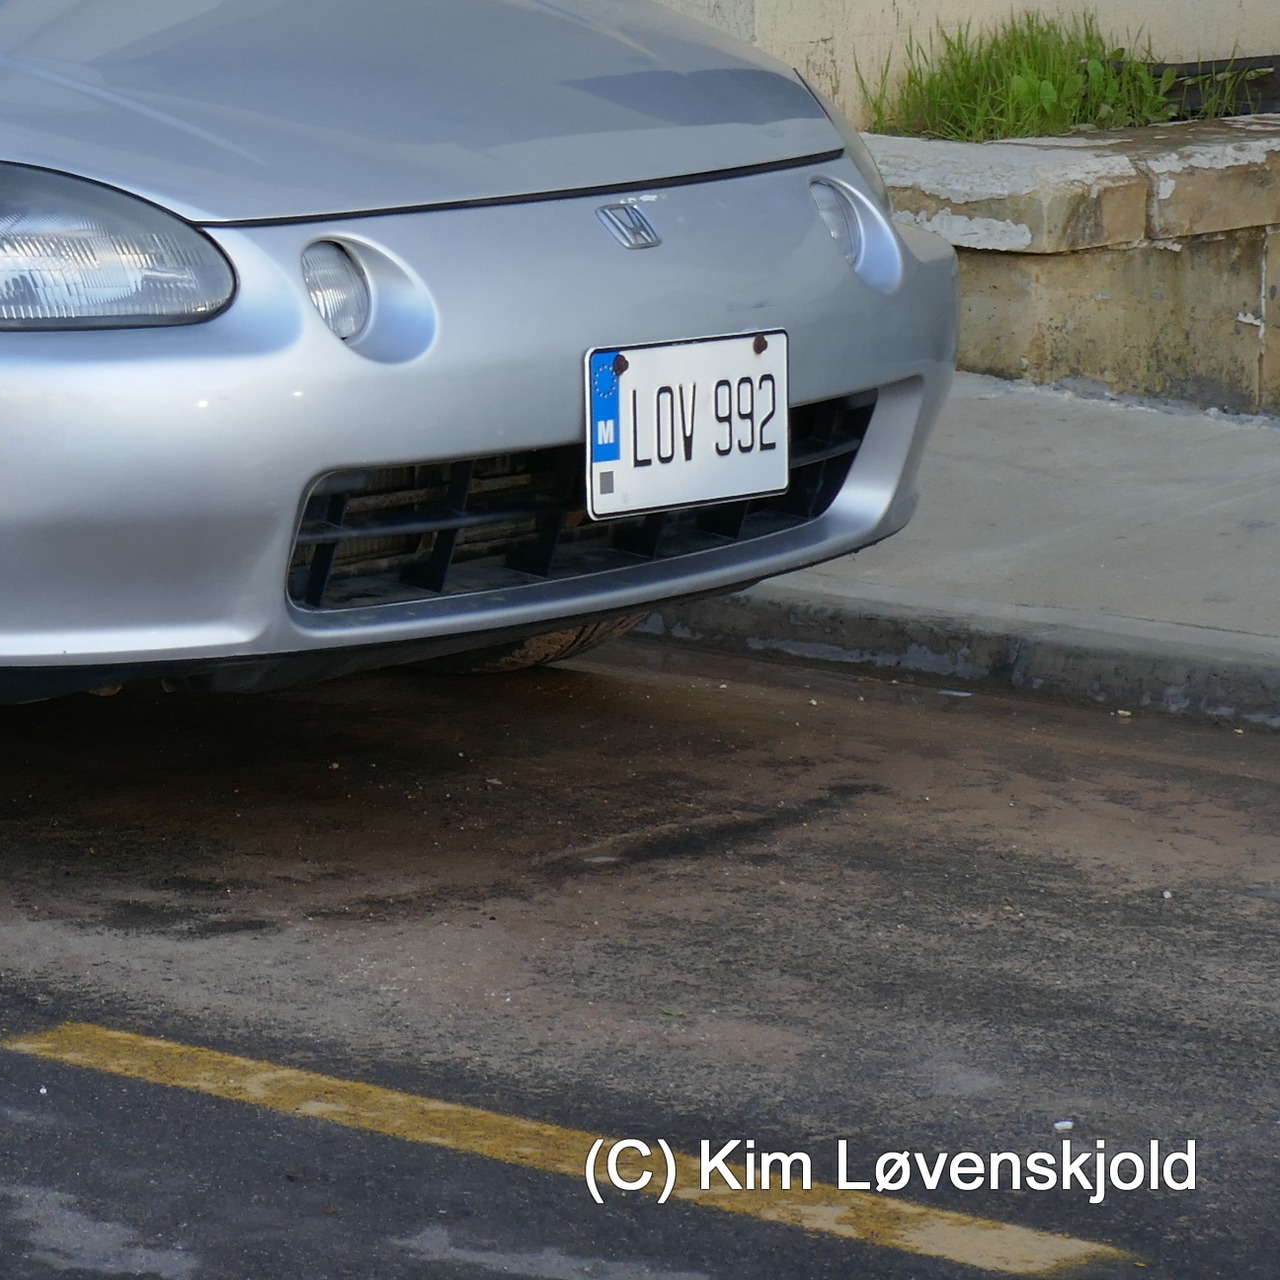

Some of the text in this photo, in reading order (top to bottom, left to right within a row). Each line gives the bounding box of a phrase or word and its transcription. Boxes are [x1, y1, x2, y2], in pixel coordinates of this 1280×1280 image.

[597, 420, 614, 445] M
[632, 373, 777, 468] LOV 992
